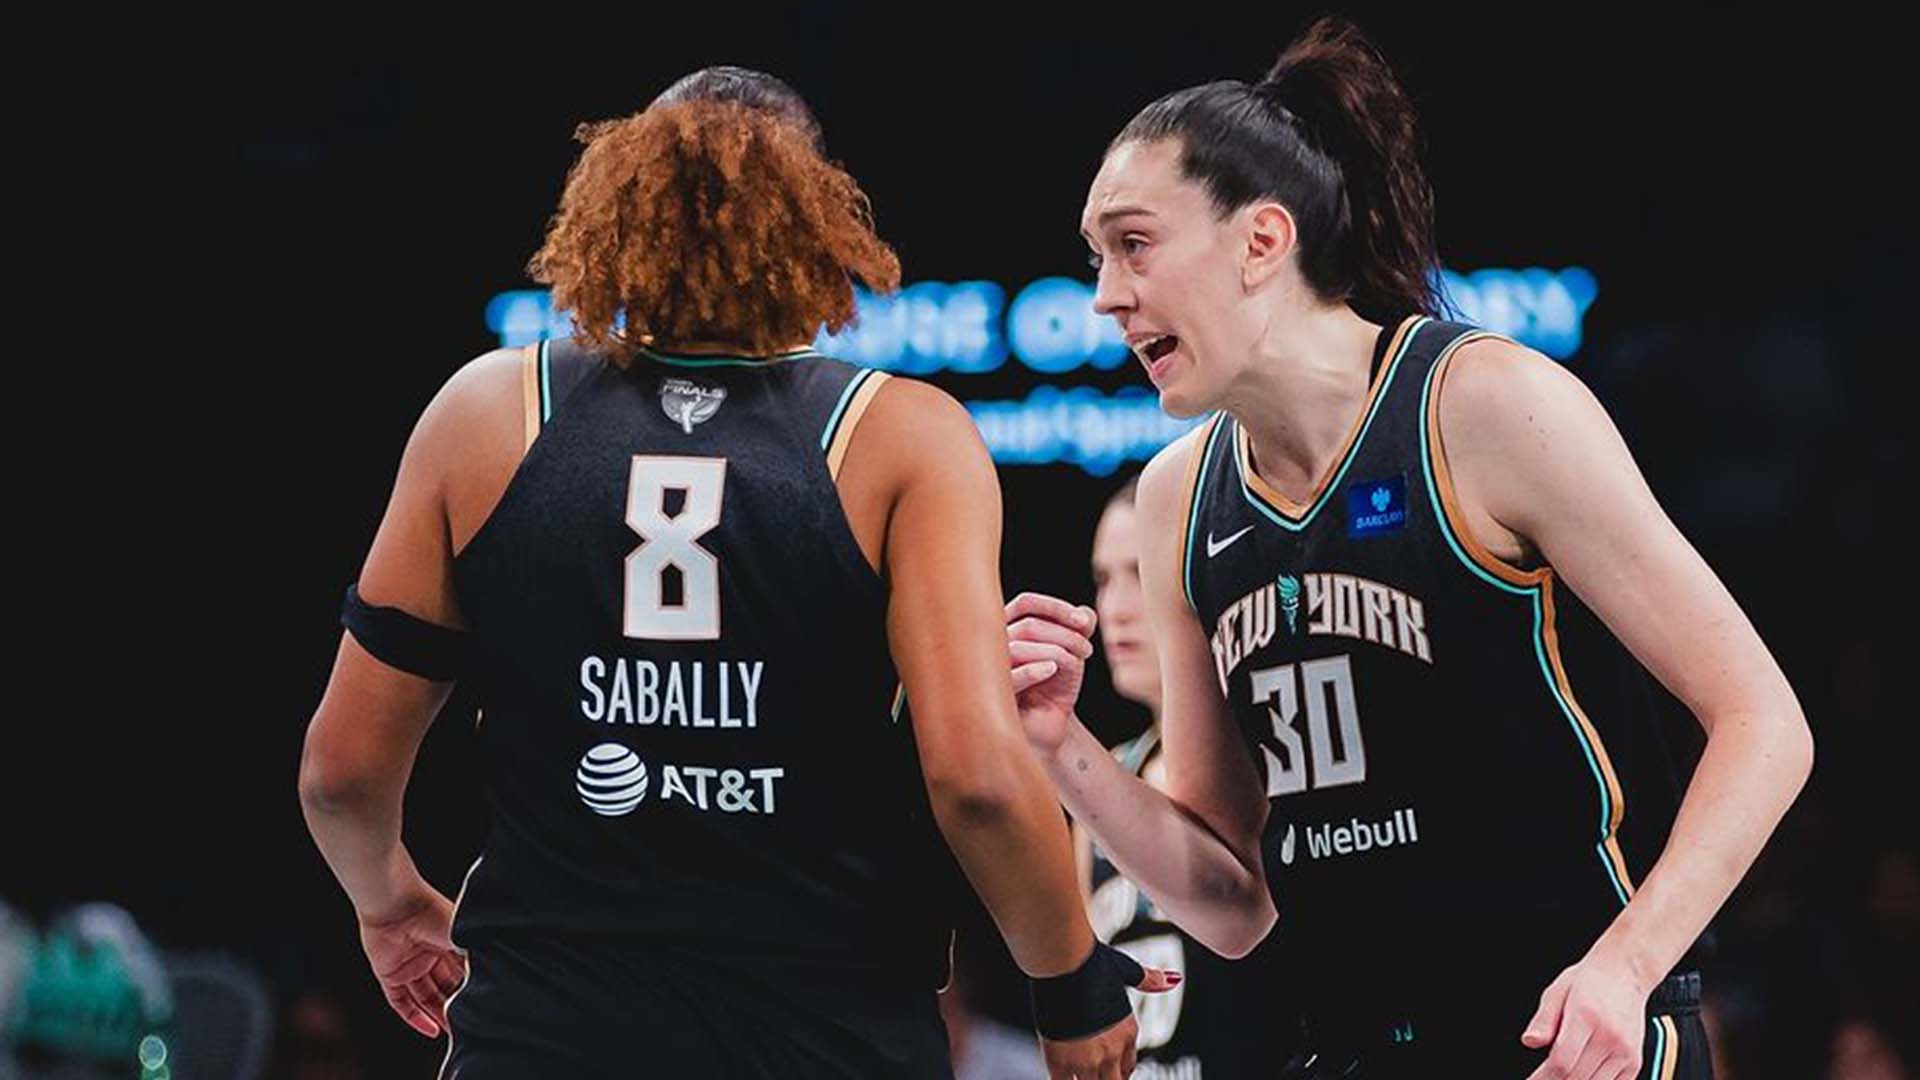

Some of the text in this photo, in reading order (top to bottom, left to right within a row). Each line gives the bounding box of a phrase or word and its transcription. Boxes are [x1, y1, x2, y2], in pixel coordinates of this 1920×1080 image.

[662, 385, 727, 399] FINALS
[622, 454, 727, 640] 8
[1303, 572, 1433, 665] YORK
[580, 655, 764, 728] SABALLY
[1249, 653, 1366, 798] 30
[660, 764, 784, 814] AT&T
[1306, 808, 1418, 859] Webull
